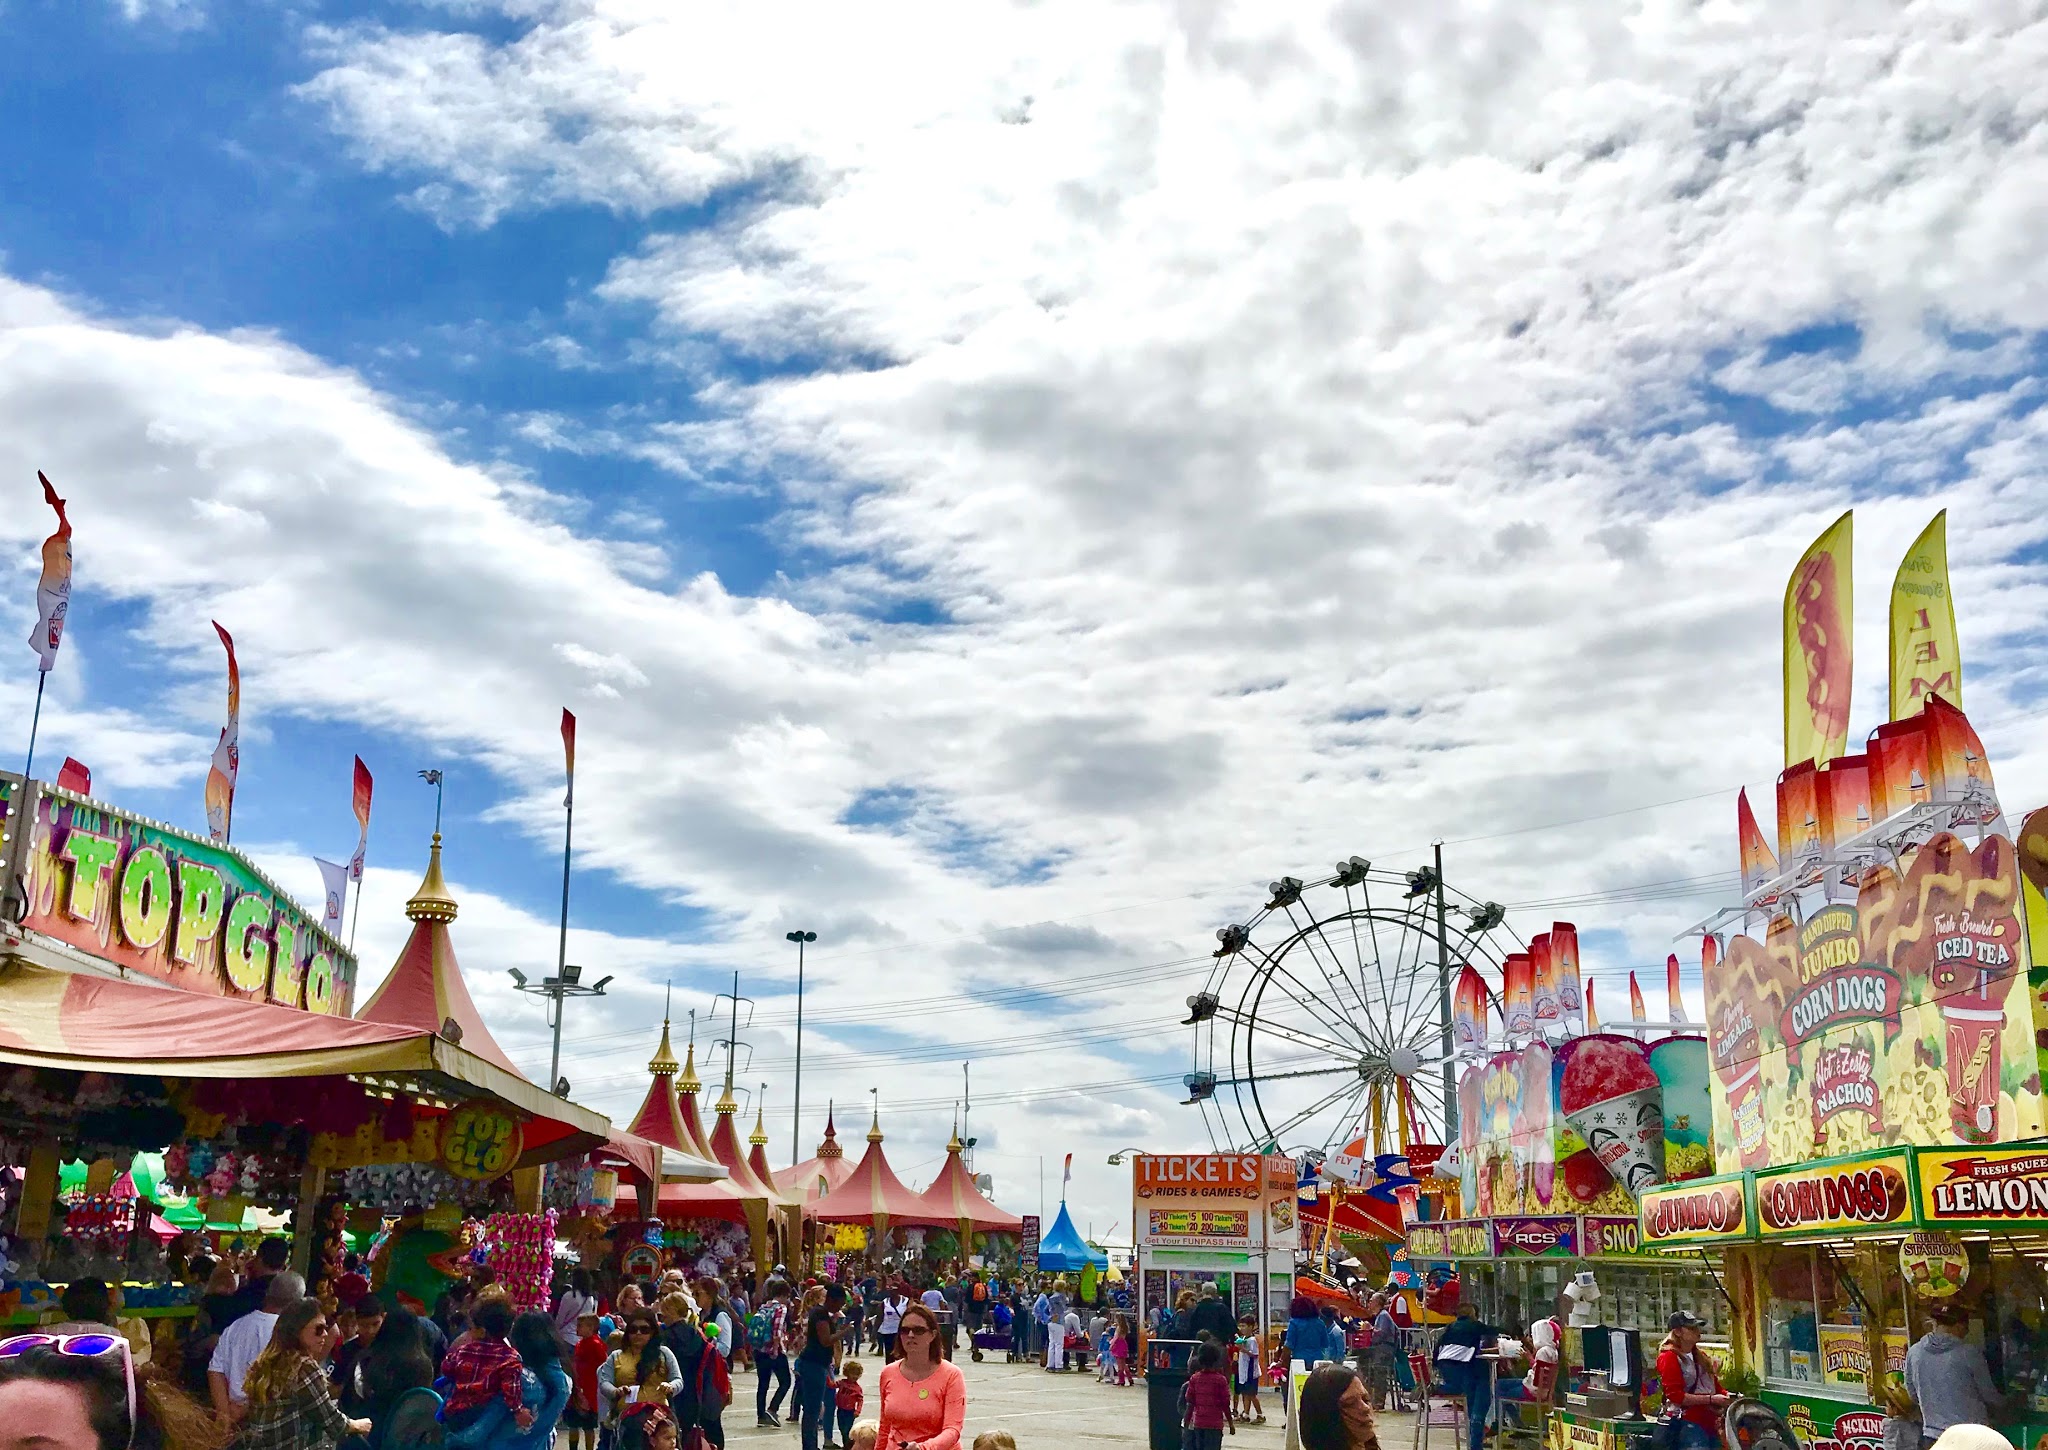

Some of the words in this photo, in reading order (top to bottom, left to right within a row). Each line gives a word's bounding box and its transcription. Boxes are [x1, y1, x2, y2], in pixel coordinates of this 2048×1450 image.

[1801, 919, 1823, 950] HAND
[1823, 912, 1853, 932] DIPPED
[1934, 912, 1956, 936] Fresh
[1960, 910, 1994, 937] Brewed
[1801, 936, 1860, 984] JUMBO
[1936, 938, 1973, 962] ICED
[1976, 940, 2010, 964] TEA
[1792, 981, 1835, 1037] CORN
[1836, 975, 1886, 1012] DOGS
[1716, 1014, 1753, 1058] LIMEADE
[1817, 1051, 1837, 1090] Hot
[1840, 1047, 1871, 1082] Zesty
[1817, 1082, 1874, 1117] NACHOS
[456, 1112, 513, 1143] TOP
[446, 1136, 503, 1171] GLO
[1335, 1156, 1353, 1166] FLY
[1140, 1157, 1258, 1182] TICKETS
[1267, 1158, 1296, 1175] TICKETS
[1352, 1170, 1358, 1178] 7
[1973, 1164, 2009, 1176] FRESH
[1155, 1187, 1187, 1197] RIDES
[1190, 1187, 1198, 1196] &
[1201, 1187, 1241, 1197] GAMES
[1773, 1178, 1824, 1225] CORN
[1825, 1170, 1887, 1220] DOGS
[1201, 1212, 1214, 1222] 100
[1656, 1191, 1726, 1235] JUMBO
[1201, 1223, 1214, 1231] 200
[1515, 1233, 1556, 1244] RCS
[1603, 1224, 1637, 1254] SNO
[1914, 1233, 1947, 1243] REFILL
[1145, 1236, 1159, 1244] Get
[1162, 1237, 1180, 1245] Your
[1905, 1243, 1960, 1255] STATION
[1789, 1404, 1811, 1416] FRESH
[1788, 1417, 1818, 1436] QUEEZED
